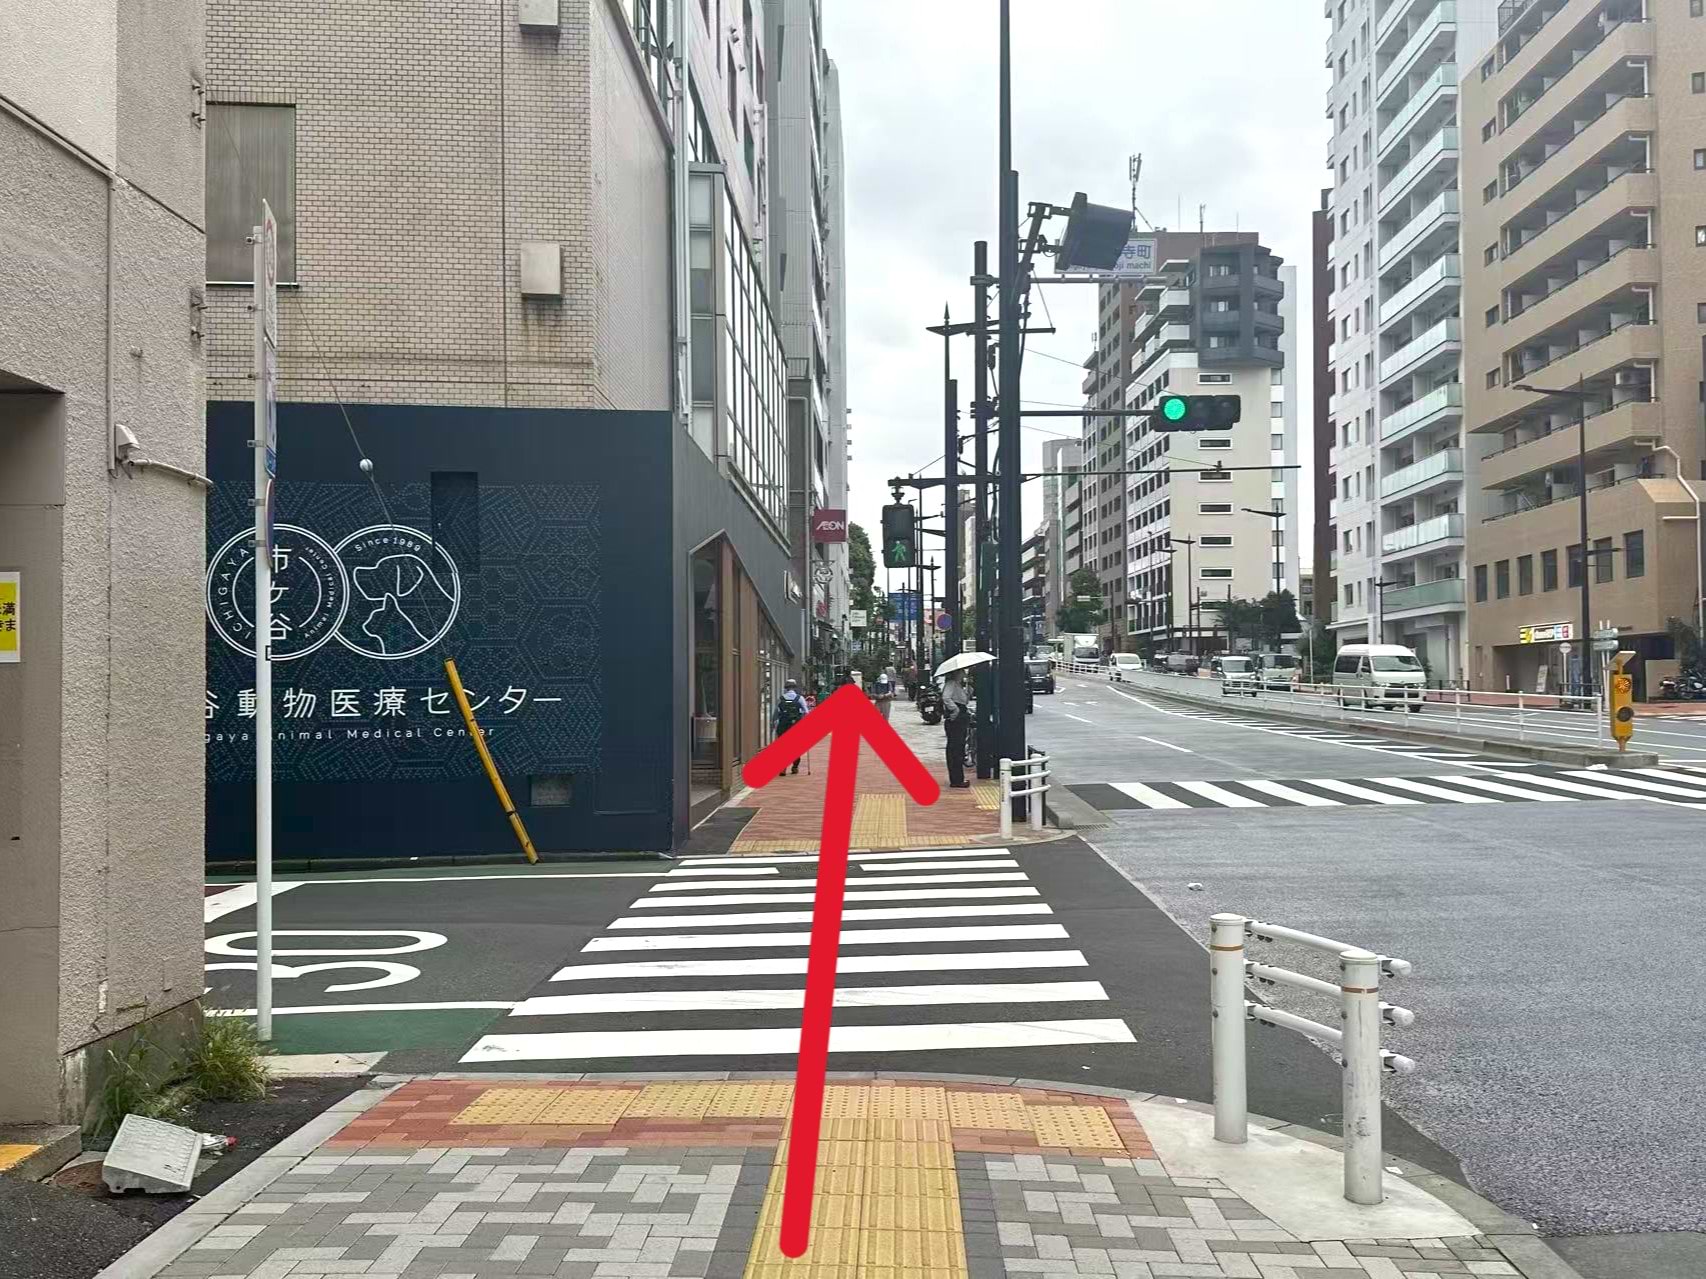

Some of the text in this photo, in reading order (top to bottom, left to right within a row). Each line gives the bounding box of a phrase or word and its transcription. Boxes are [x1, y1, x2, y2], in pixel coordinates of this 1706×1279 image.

[1127, 261, 1151, 269] machi
[355, 536, 421, 552] Since 1989
[218, 548, 251, 639] ICHIGAYA
[304, 612, 329, 639] Animal
[325, 573, 335, 608] Medical
[271, 730, 332, 740] nimal
[347, 728, 422, 739] Medical
[433, 727, 495, 738] Cener
